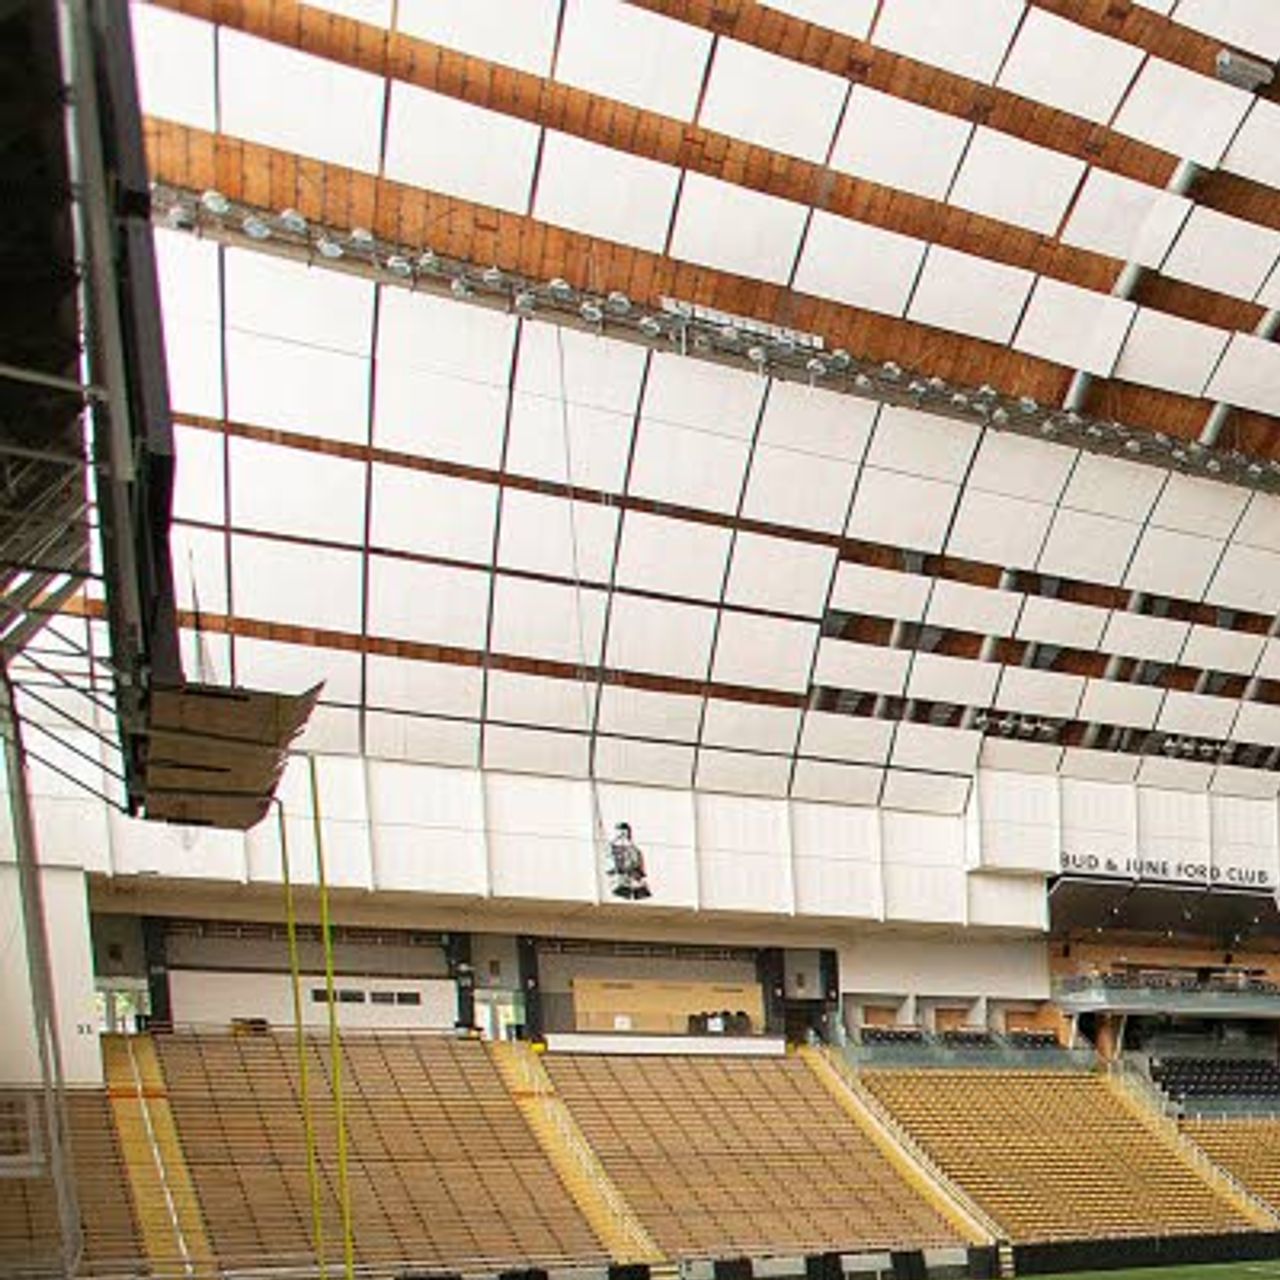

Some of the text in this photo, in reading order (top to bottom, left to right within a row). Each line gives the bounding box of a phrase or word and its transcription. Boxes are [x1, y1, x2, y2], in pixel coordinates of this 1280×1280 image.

[1060, 852, 1269, 884] BUD & JUNE FORD CLUB
